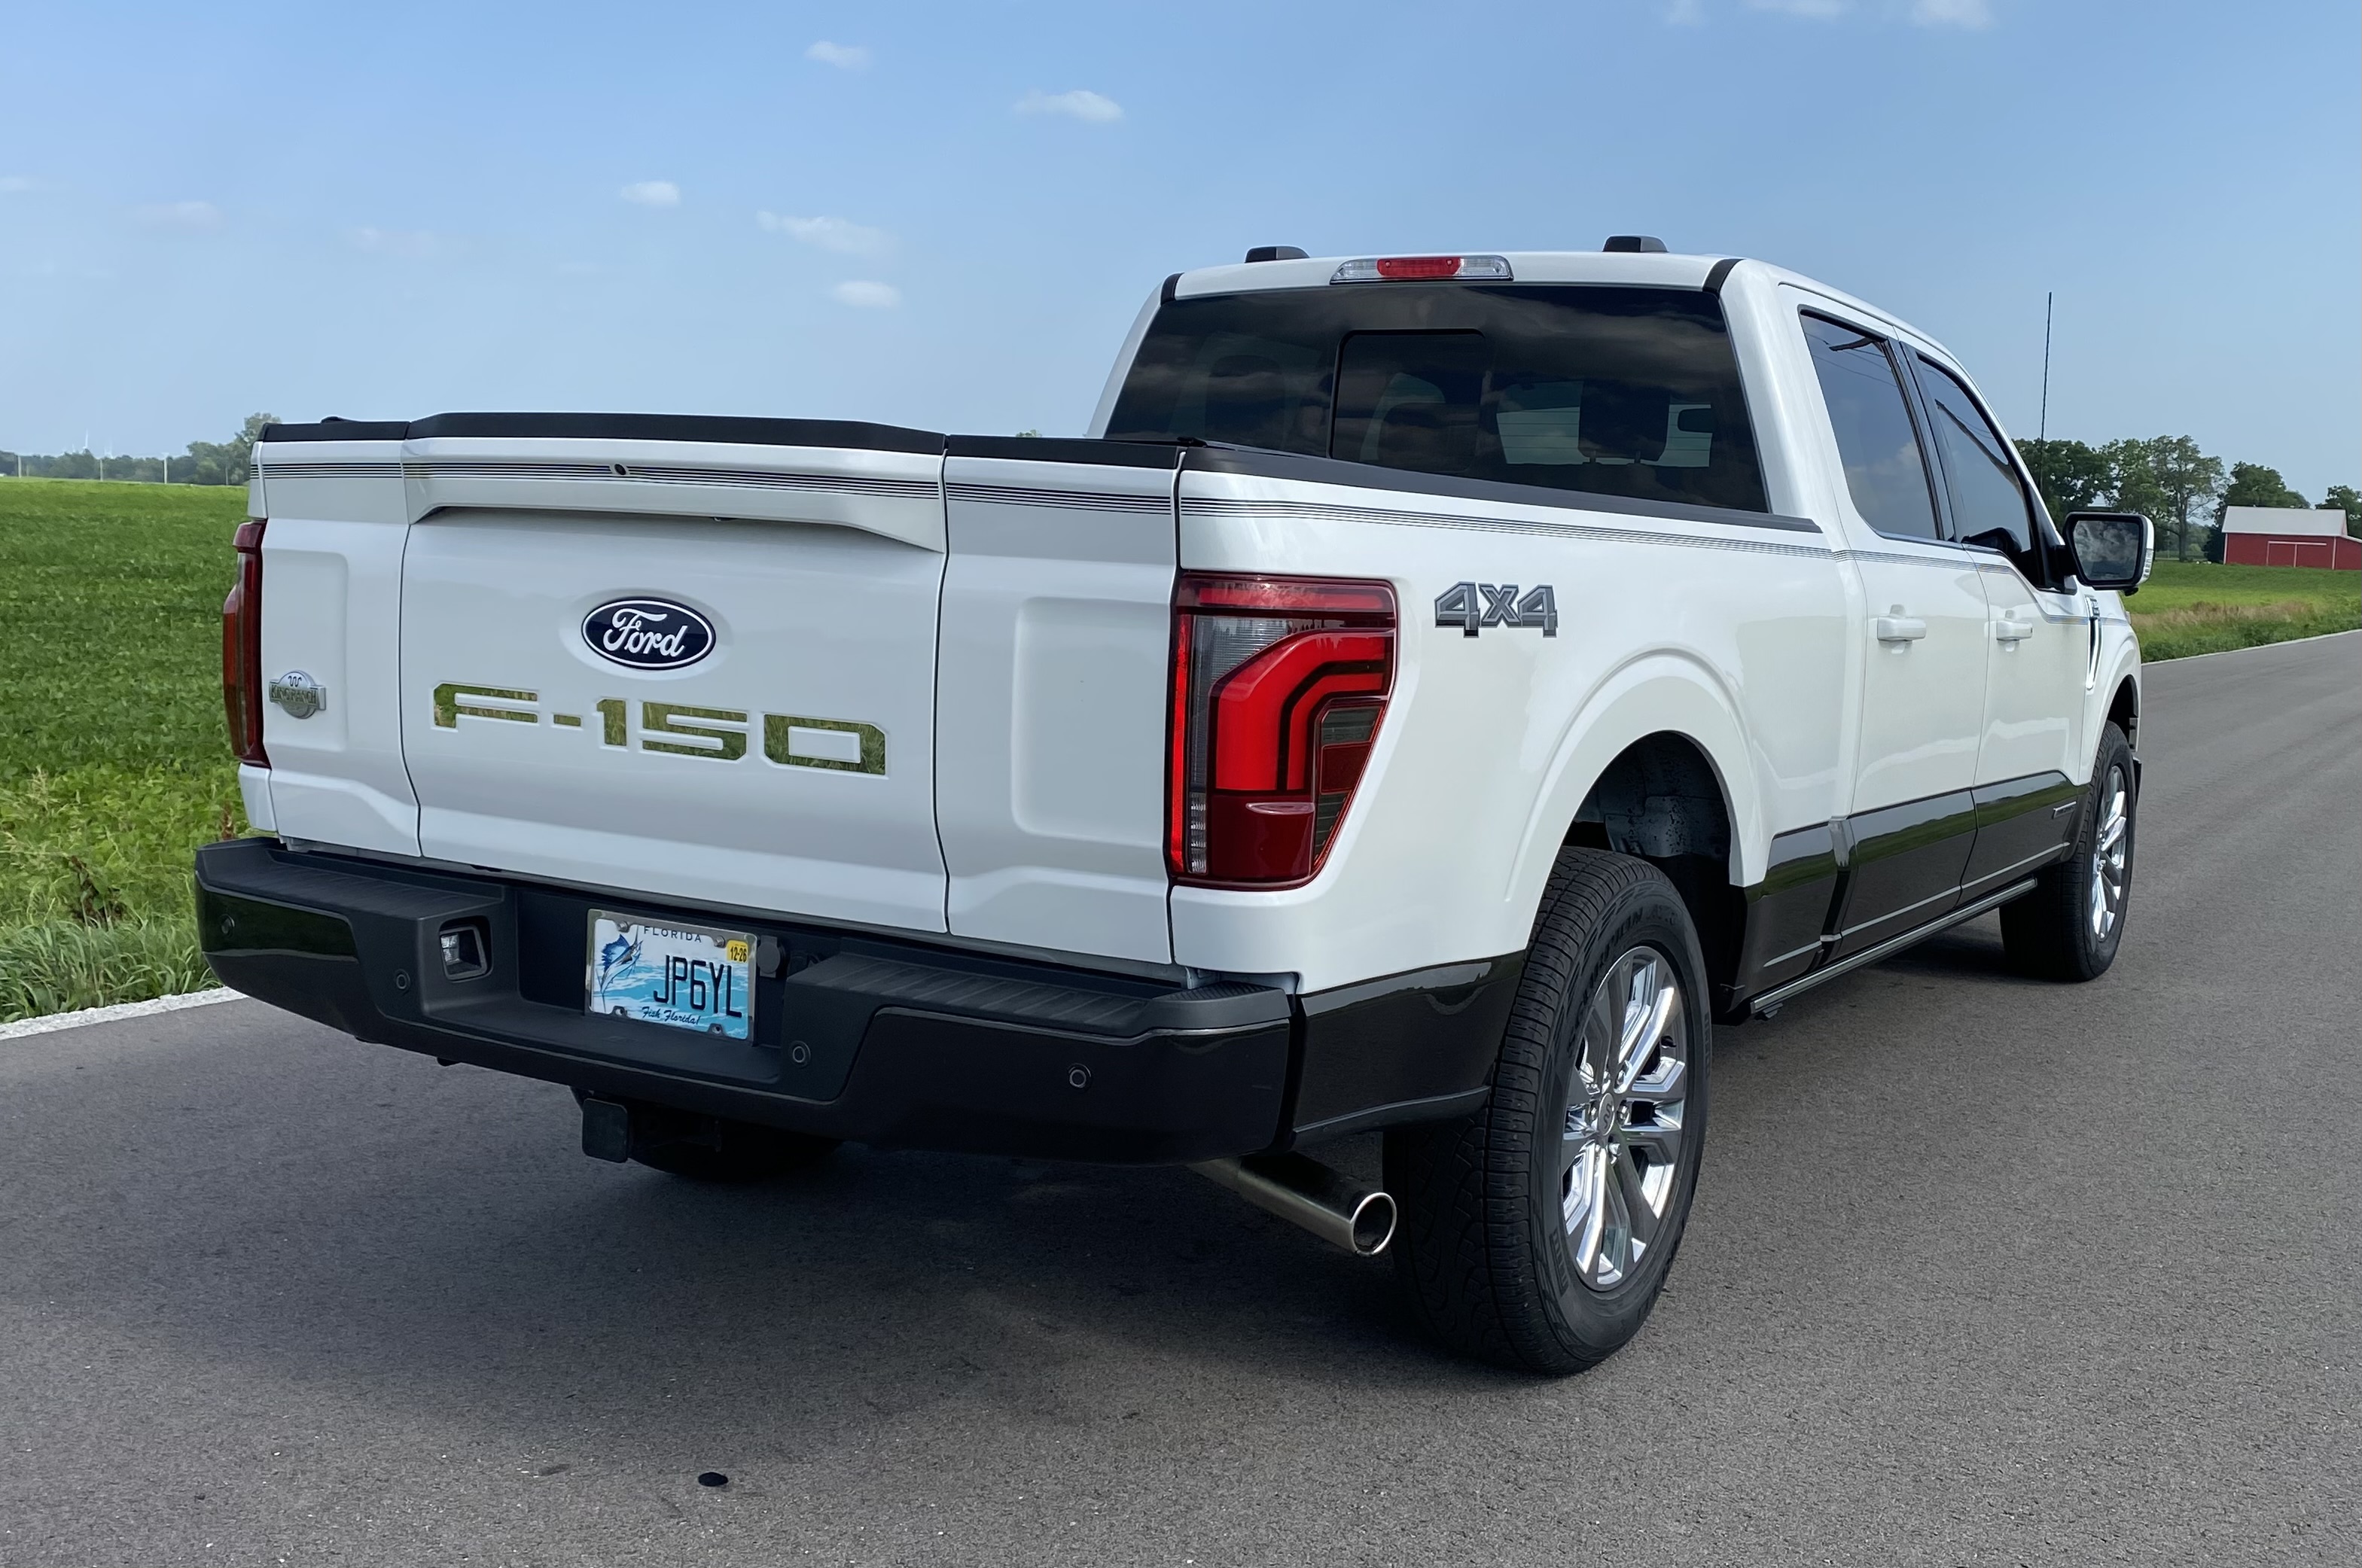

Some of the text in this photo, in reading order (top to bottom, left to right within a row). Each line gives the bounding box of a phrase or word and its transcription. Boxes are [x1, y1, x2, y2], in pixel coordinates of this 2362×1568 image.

[602, 607, 687, 657] Ford
[431, 683, 888, 778] F-150
[643, 926, 703, 943] FLORIDA
[730, 946, 747, 963] 12-26
[653, 955, 742, 1018] JP6YL
[642, 1006, 701, 1025] Fish Florida!
